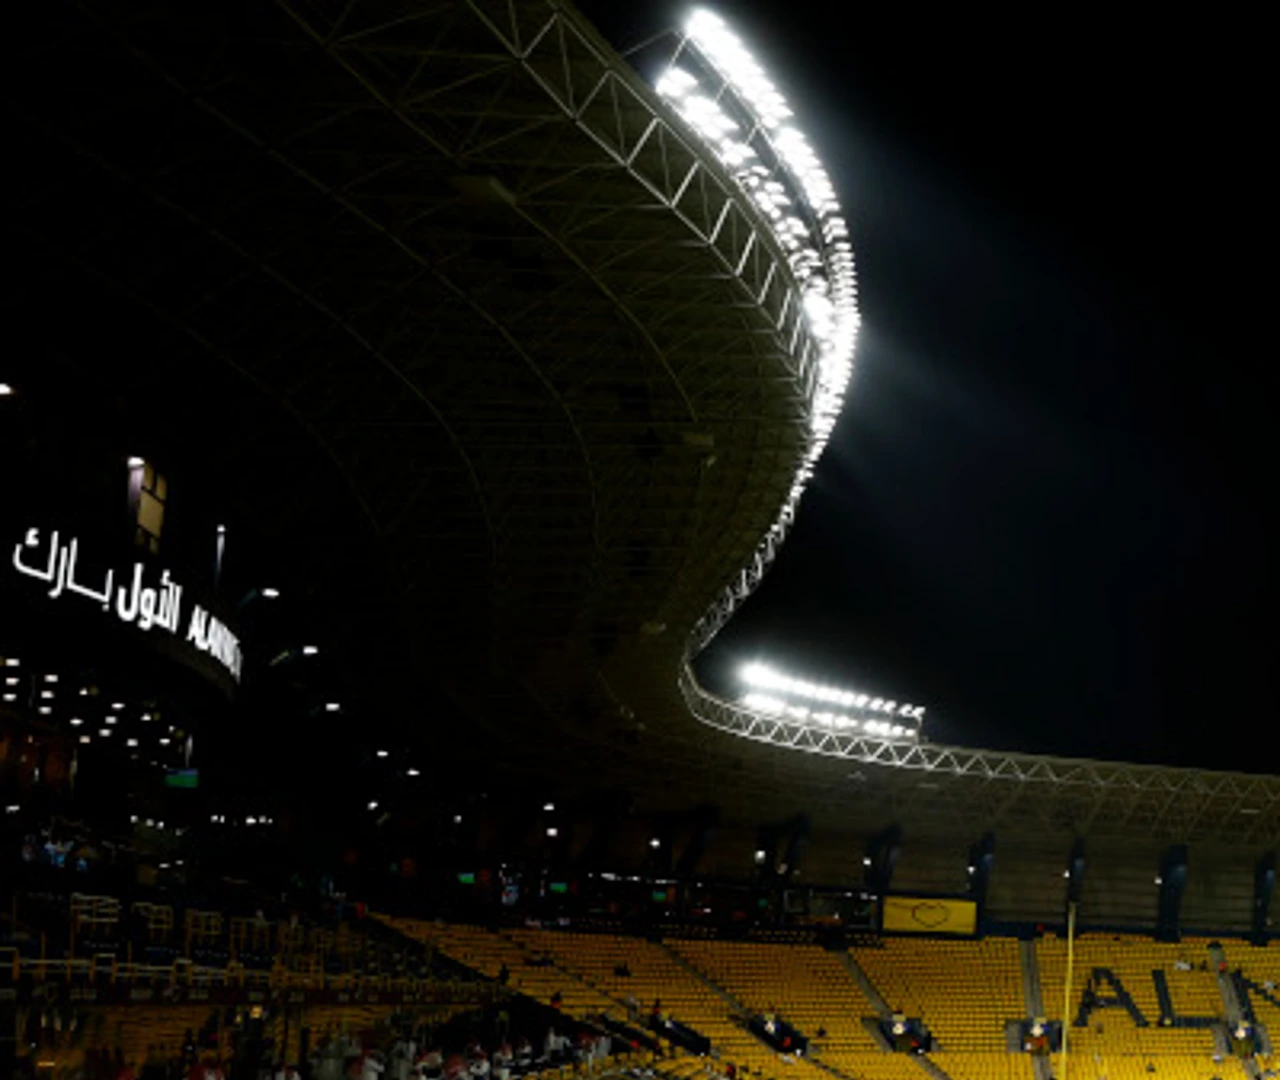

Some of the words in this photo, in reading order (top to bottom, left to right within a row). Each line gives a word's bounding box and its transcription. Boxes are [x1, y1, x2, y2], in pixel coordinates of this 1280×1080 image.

[12, 527, 113, 611] بارك
[116, 562, 182, 633] الأول
[1073, 967, 1224, 1028] AL
